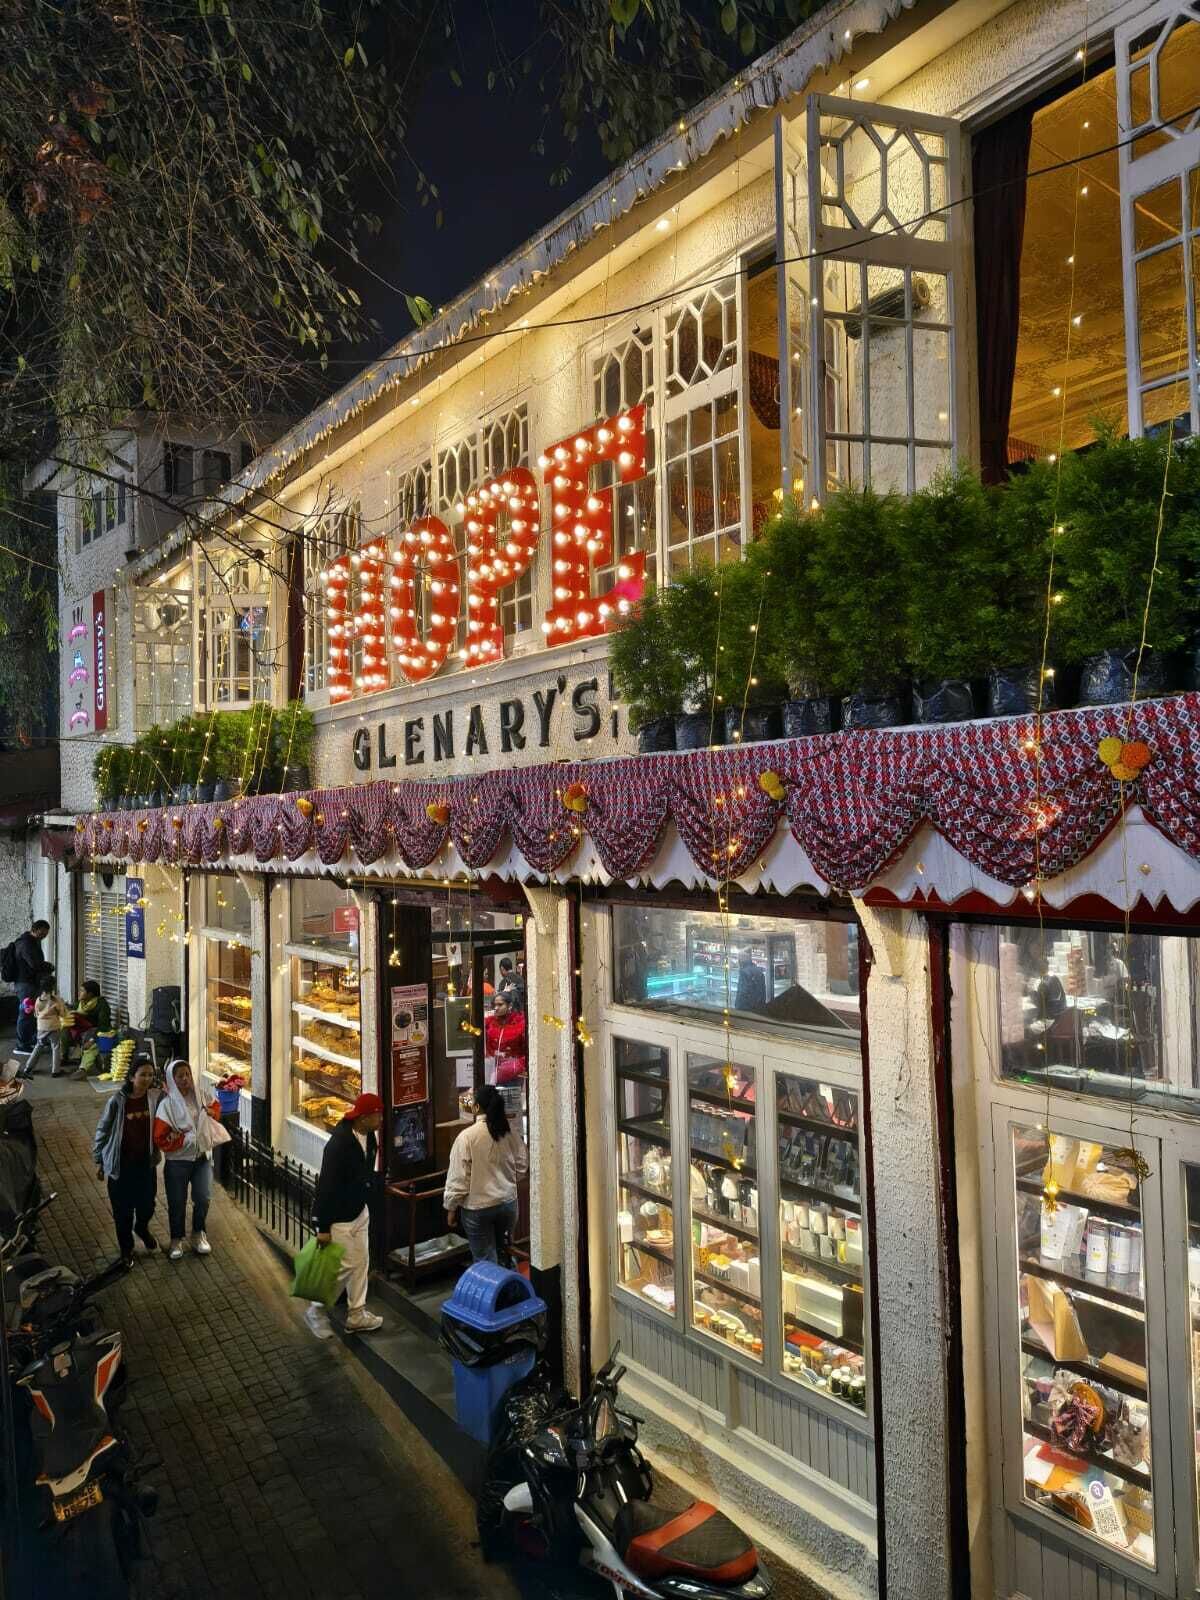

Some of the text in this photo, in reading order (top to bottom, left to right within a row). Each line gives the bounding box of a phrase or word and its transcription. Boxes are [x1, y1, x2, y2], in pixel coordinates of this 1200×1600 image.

[321, 404, 647, 705] HOPE
[95, 611, 104, 711] Glenary's
[352, 675, 600, 771] GLENARY'S
